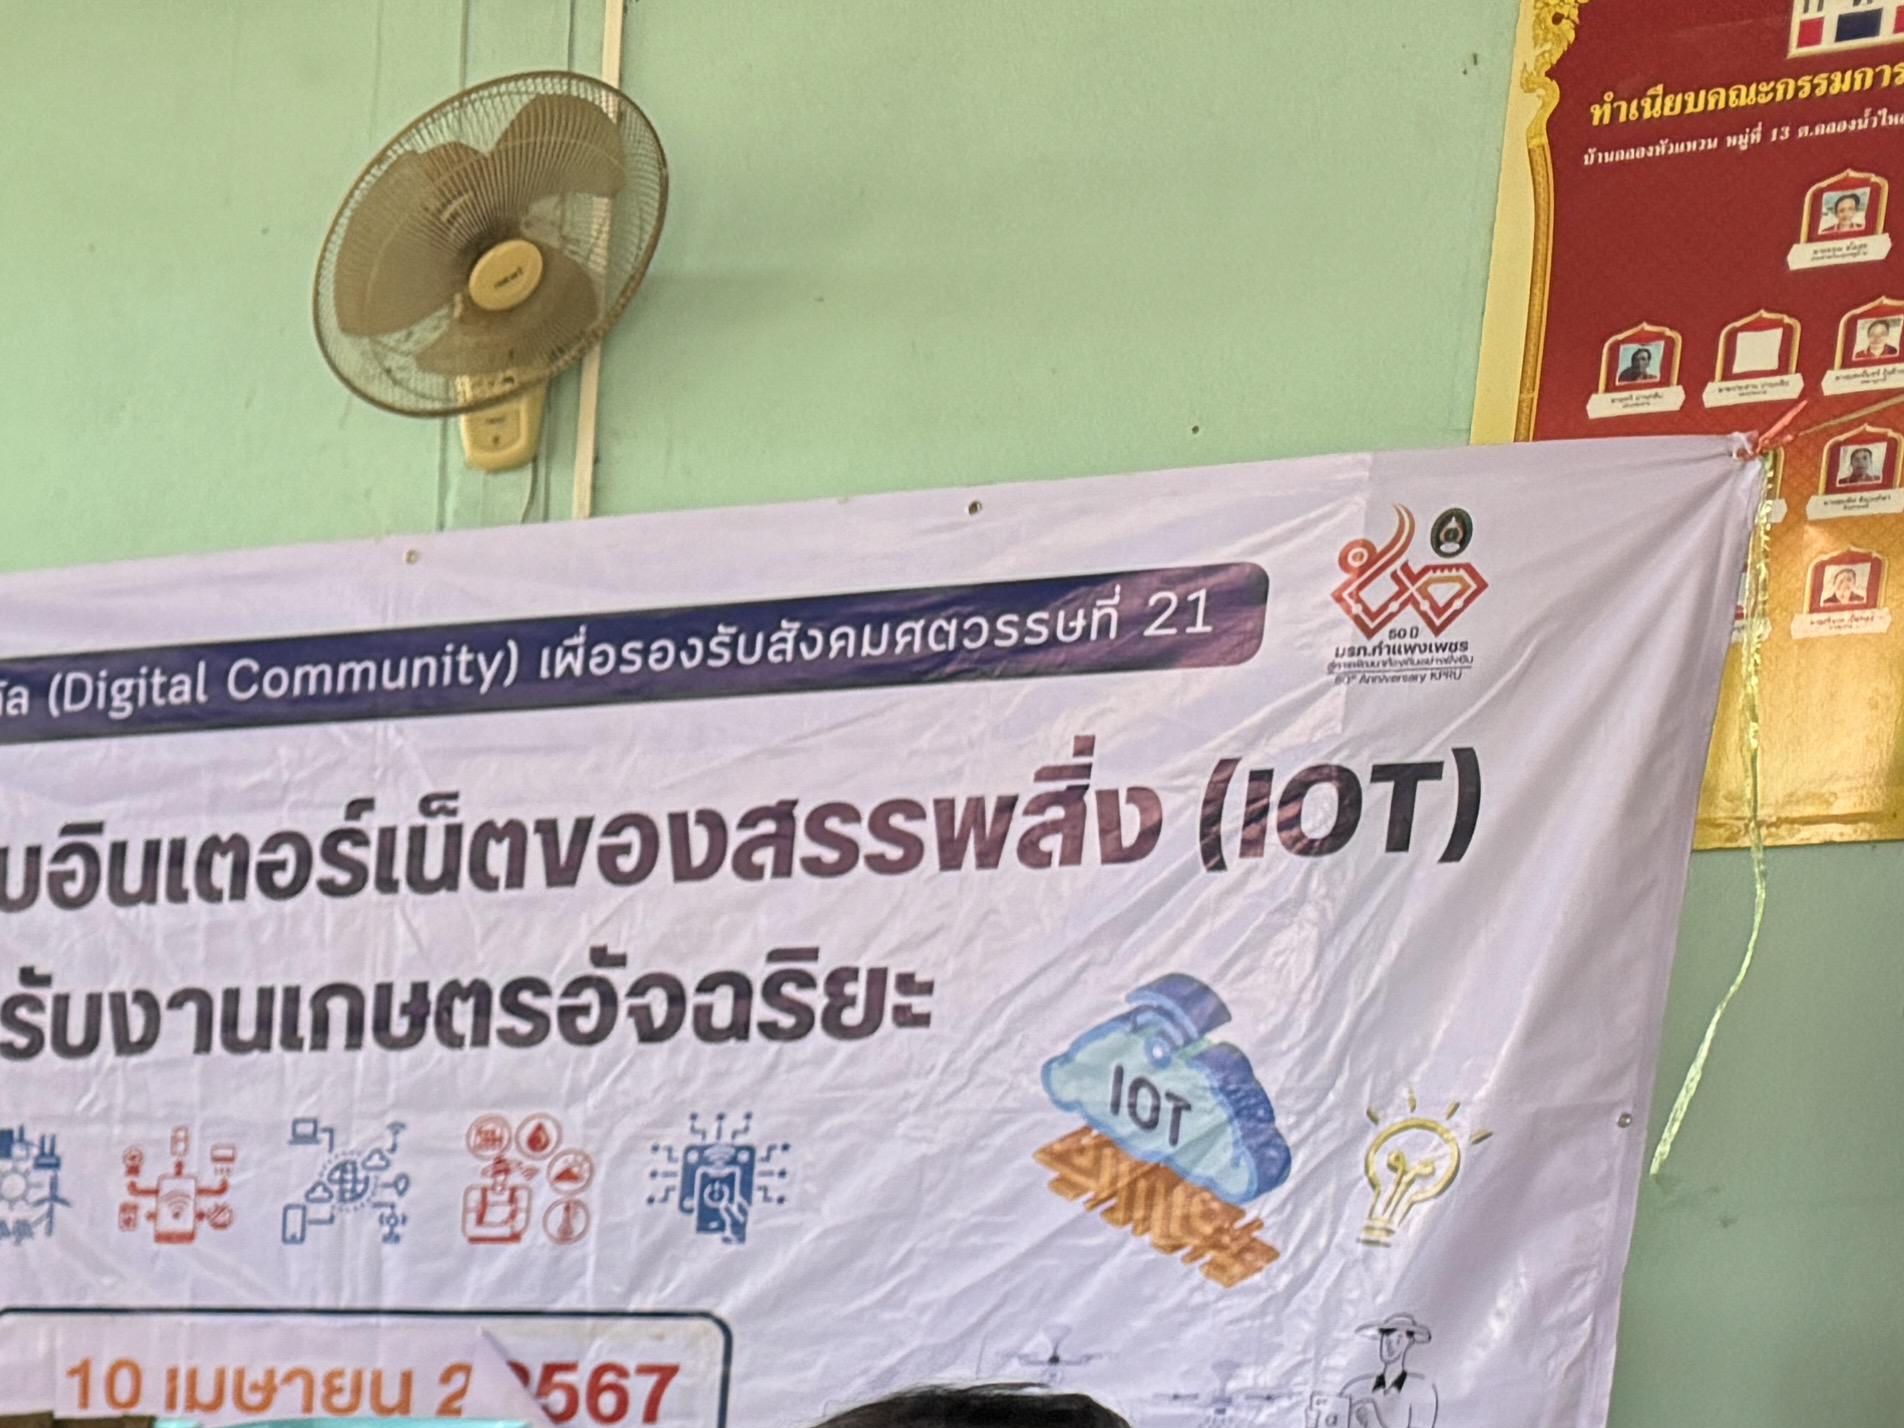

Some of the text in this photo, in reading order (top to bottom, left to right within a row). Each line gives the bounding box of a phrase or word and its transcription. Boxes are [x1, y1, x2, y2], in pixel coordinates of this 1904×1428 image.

[1770, 126, 1790, 143] 13
[47, 659, 208, 718] (Digital
[225, 637, 520, 701] Community)
[539, 583, 1122, 680] เพื่อรองรับสังคมศตวรรษที่
[1142, 587, 1215, 637] 21
[1198, 746, 1484, 874] (IOT)
[1109, 1064, 1193, 1147] IOT
[65, 1357, 142, 1410] 10
[164, 1362, 414, 1418] เมษายน
